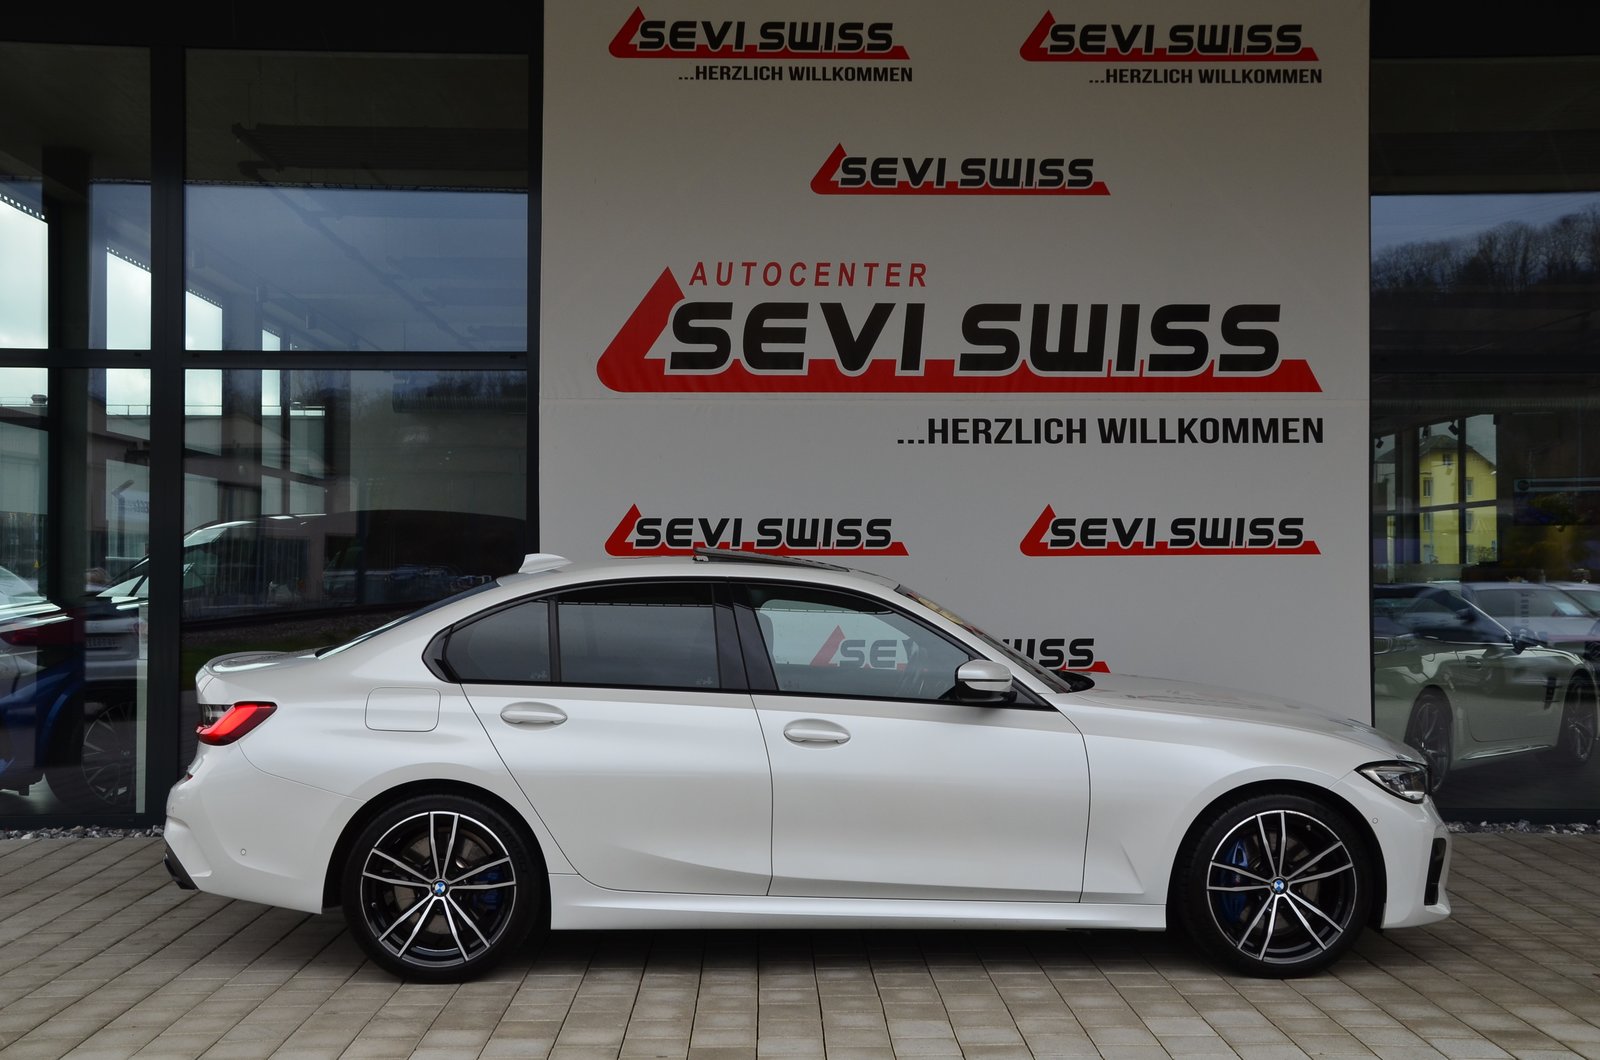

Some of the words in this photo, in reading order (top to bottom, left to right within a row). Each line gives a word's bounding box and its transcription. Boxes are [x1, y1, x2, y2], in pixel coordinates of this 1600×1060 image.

[639, 19, 746, 51] SEVI
[758, 20, 894, 52] SWISS
[1048, 23, 1156, 54] SEVI
[1167, 23, 1304, 55] SWISS
[677, 64, 784, 82] ...HERZLICH
[787, 65, 913, 83] WILLKOMMEN
[1088, 67, 1194, 85] ...HERZLICH
[1197, 67, 1323, 86] WILLKOMMEN
[840, 156, 947, 187] SEVI
[959, 157, 1095, 188] SWISS
[689, 261, 928, 288] AUTOCENTER
[669, 300, 927, 372] SEVI
[957, 302, 1281, 373] SWISS
[897, 417, 1087, 446] ...HERZLICH
[1097, 417, 1324, 445] WILLKOMMEN
[635, 517, 743, 548] SEVI
[756, 517, 892, 548] SWISS
[1049, 517, 1156, 547] SEVI
[1169, 517, 1304, 547] SWISS
